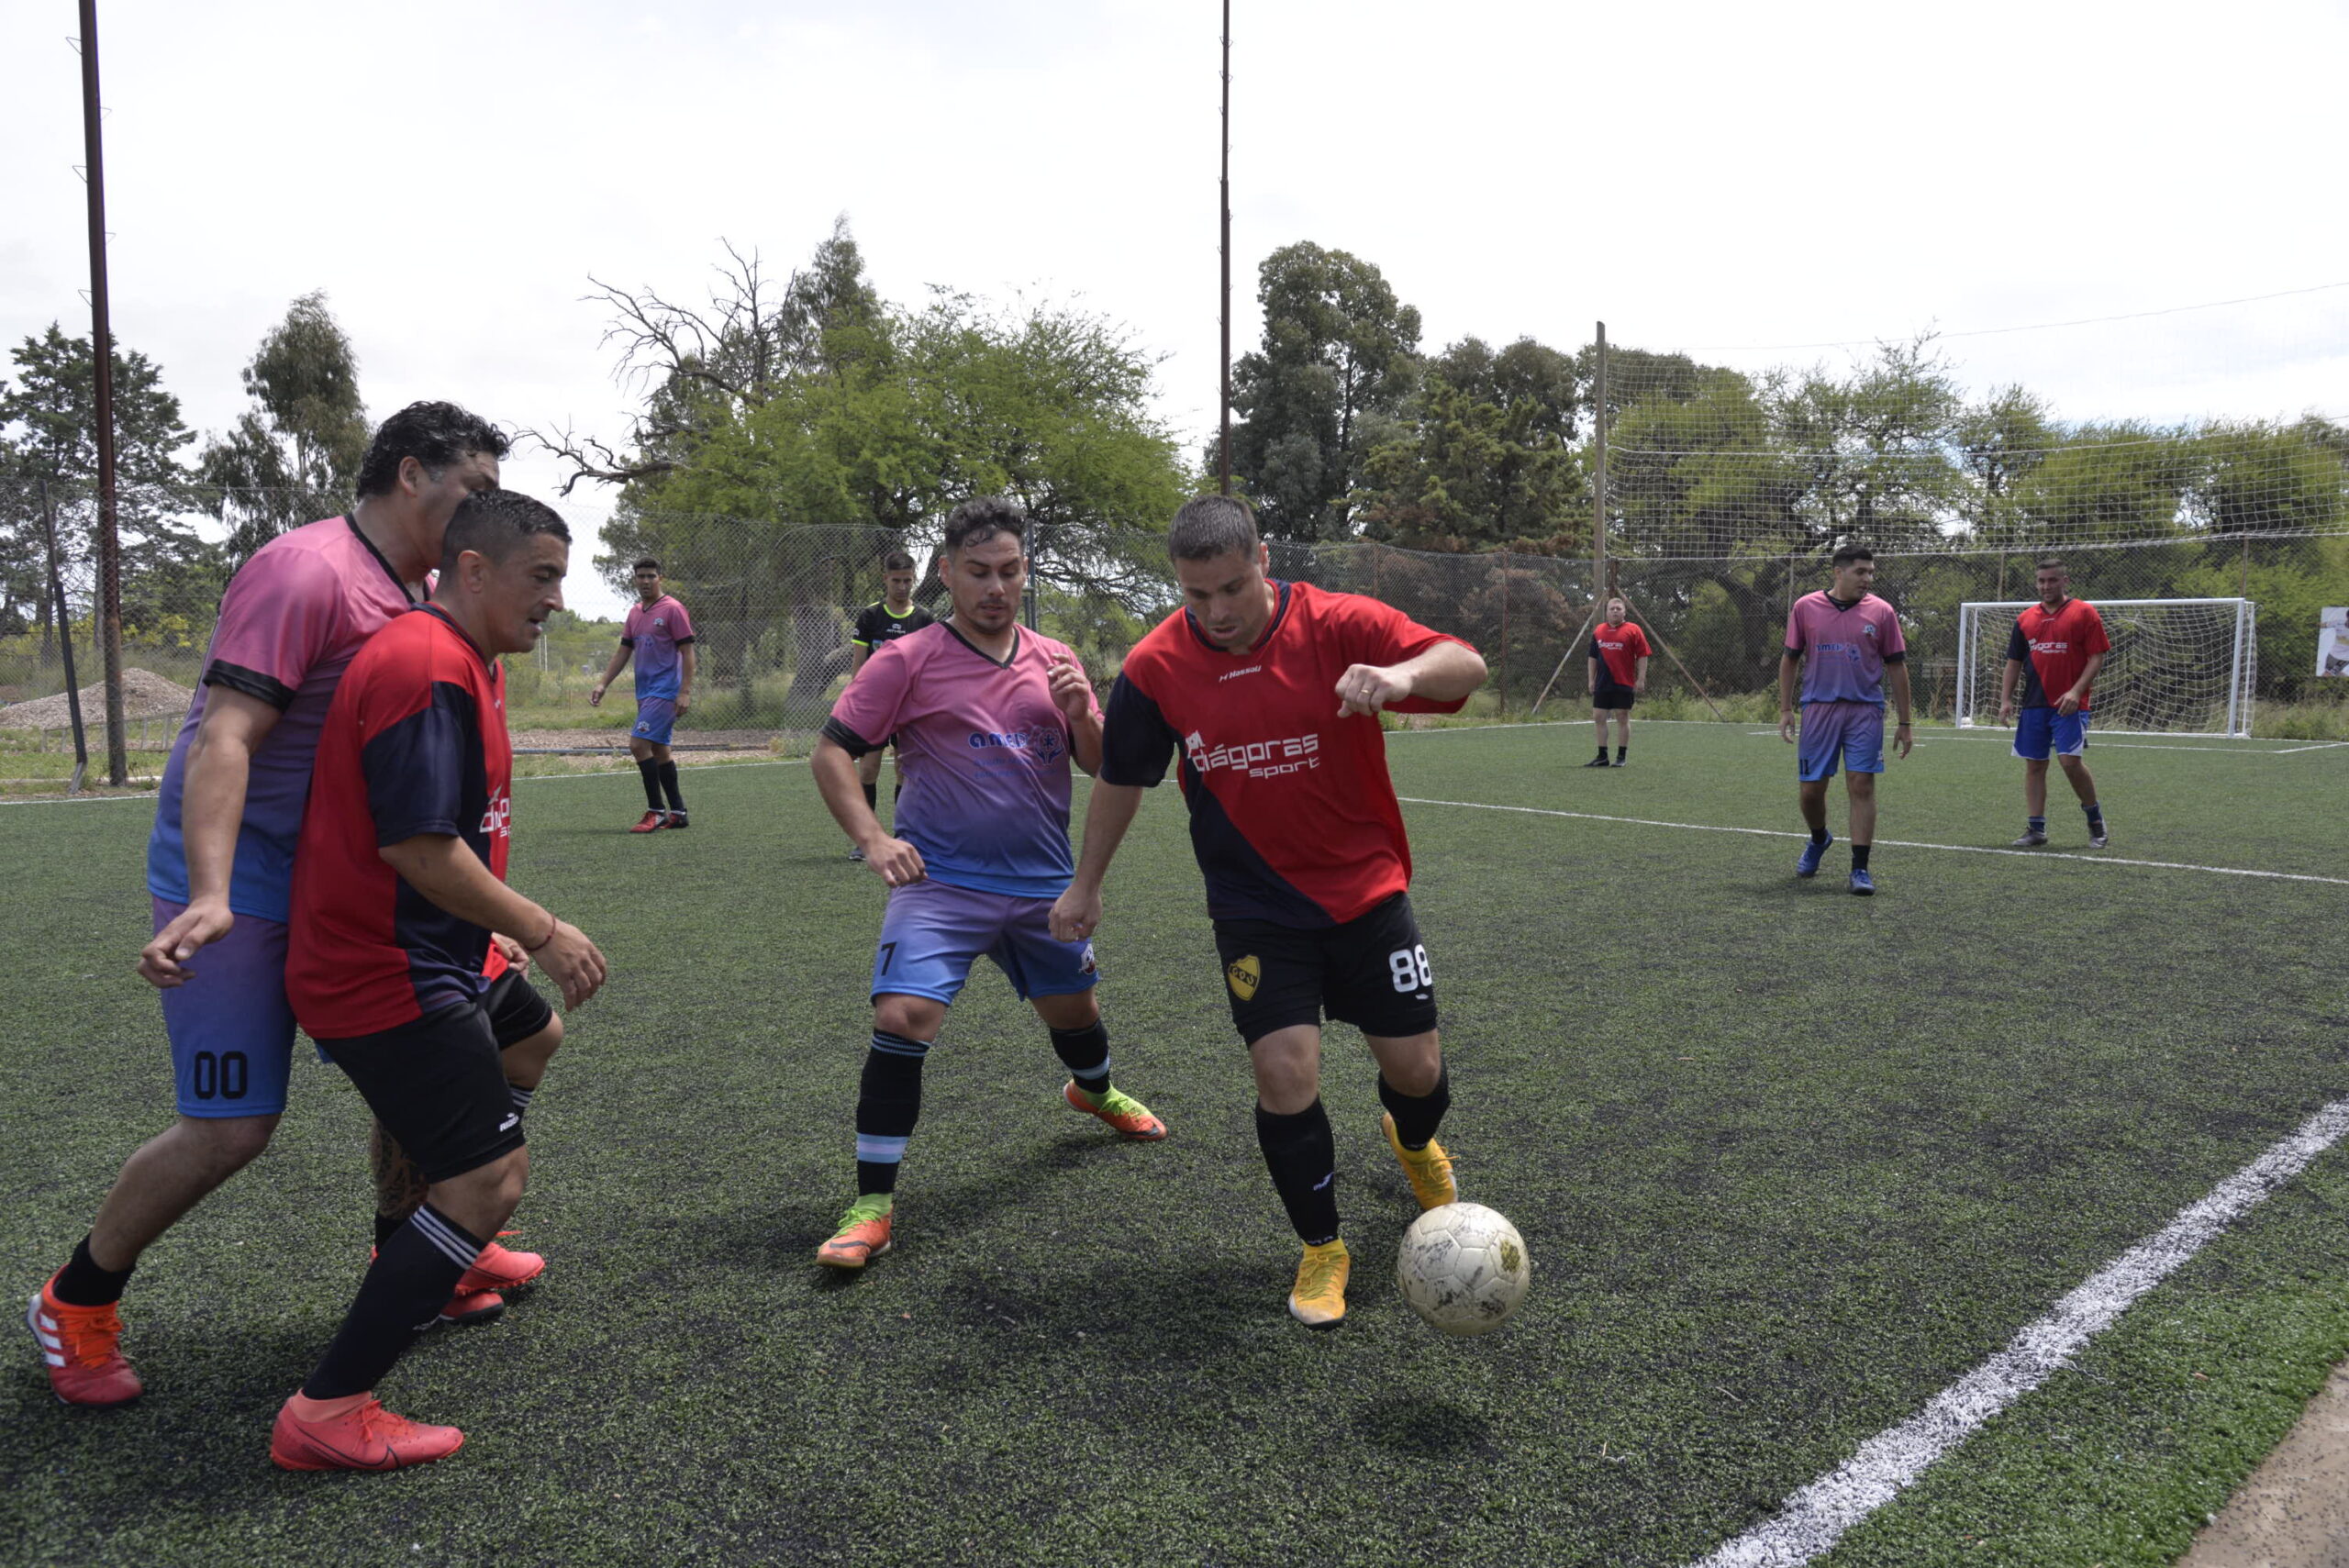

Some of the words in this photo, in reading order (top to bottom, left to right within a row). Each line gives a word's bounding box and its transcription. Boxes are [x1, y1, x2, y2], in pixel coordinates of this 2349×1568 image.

[1249, 757, 1319, 779] sport
[880, 941, 897, 976] 7
[1388, 943, 1432, 993] 88
[195, 1051, 248, 1099] 00
